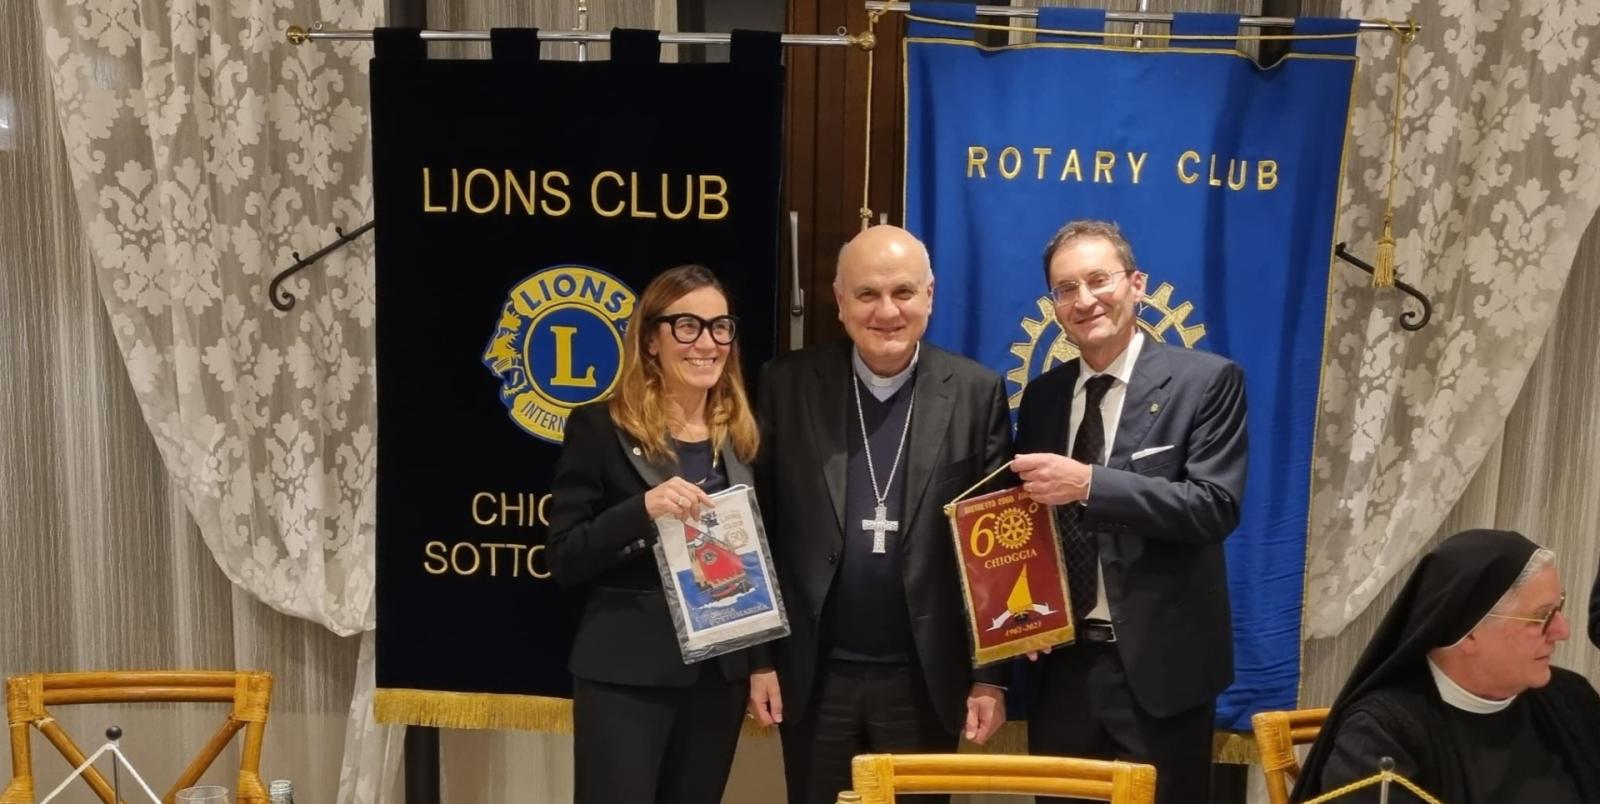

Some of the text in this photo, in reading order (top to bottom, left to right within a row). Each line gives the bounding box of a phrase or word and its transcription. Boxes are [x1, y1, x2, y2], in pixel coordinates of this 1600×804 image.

[966, 145, 1280, 191] ROTARY CLUB
[422, 167, 729, 220] LIONS CLUB
[520, 274, 626, 313] LIONS
[550, 326, 597, 387] L
[984, 548, 1038, 569] CHIOGGIA
